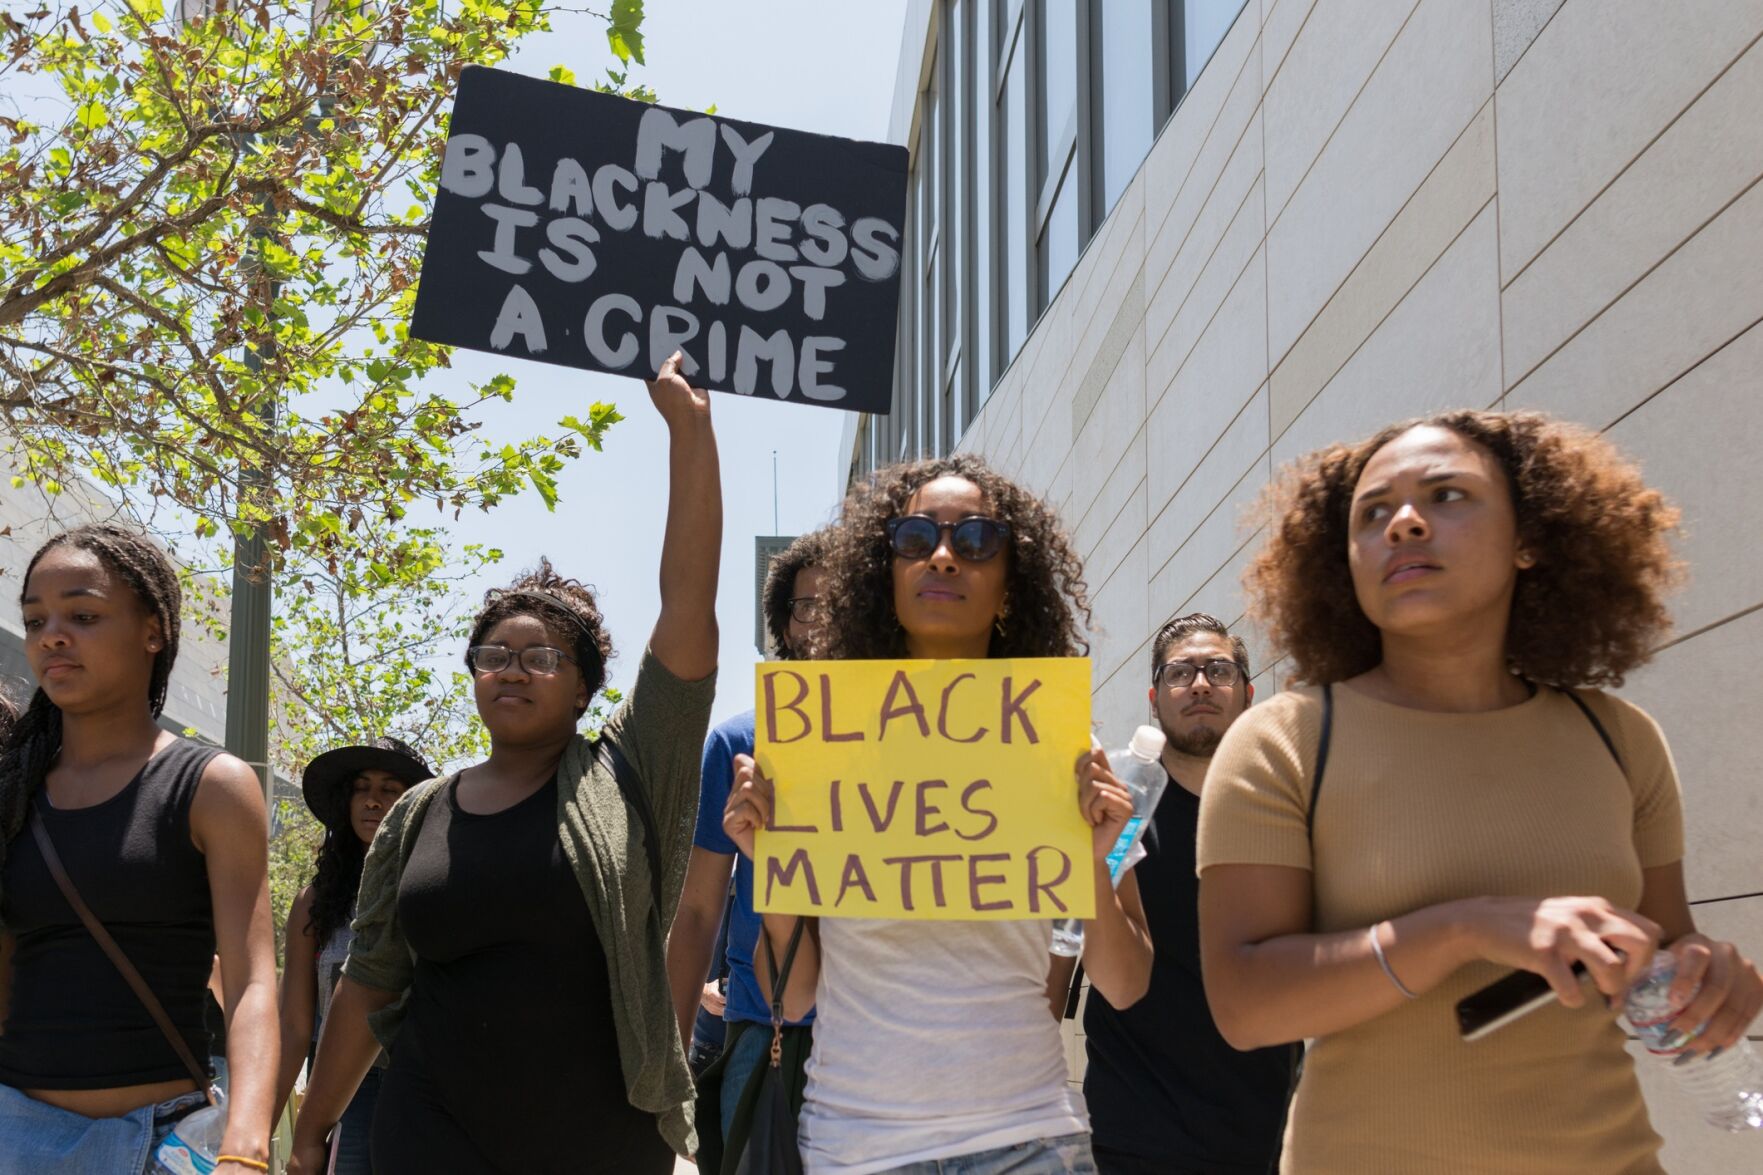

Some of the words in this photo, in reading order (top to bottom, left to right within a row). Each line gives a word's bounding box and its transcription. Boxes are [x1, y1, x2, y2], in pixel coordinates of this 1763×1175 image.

[635, 107, 774, 197] MY
[440, 133, 900, 282] BLACKNESS
[477, 203, 600, 283] IS
[673, 246, 846, 320] NOT
[490, 284, 547, 353] A
[584, 293, 847, 401] CRIME
[763, 670, 1042, 744] BLACK
[764, 779, 998, 841] LIVES
[765, 845, 1072, 913] MATTER
